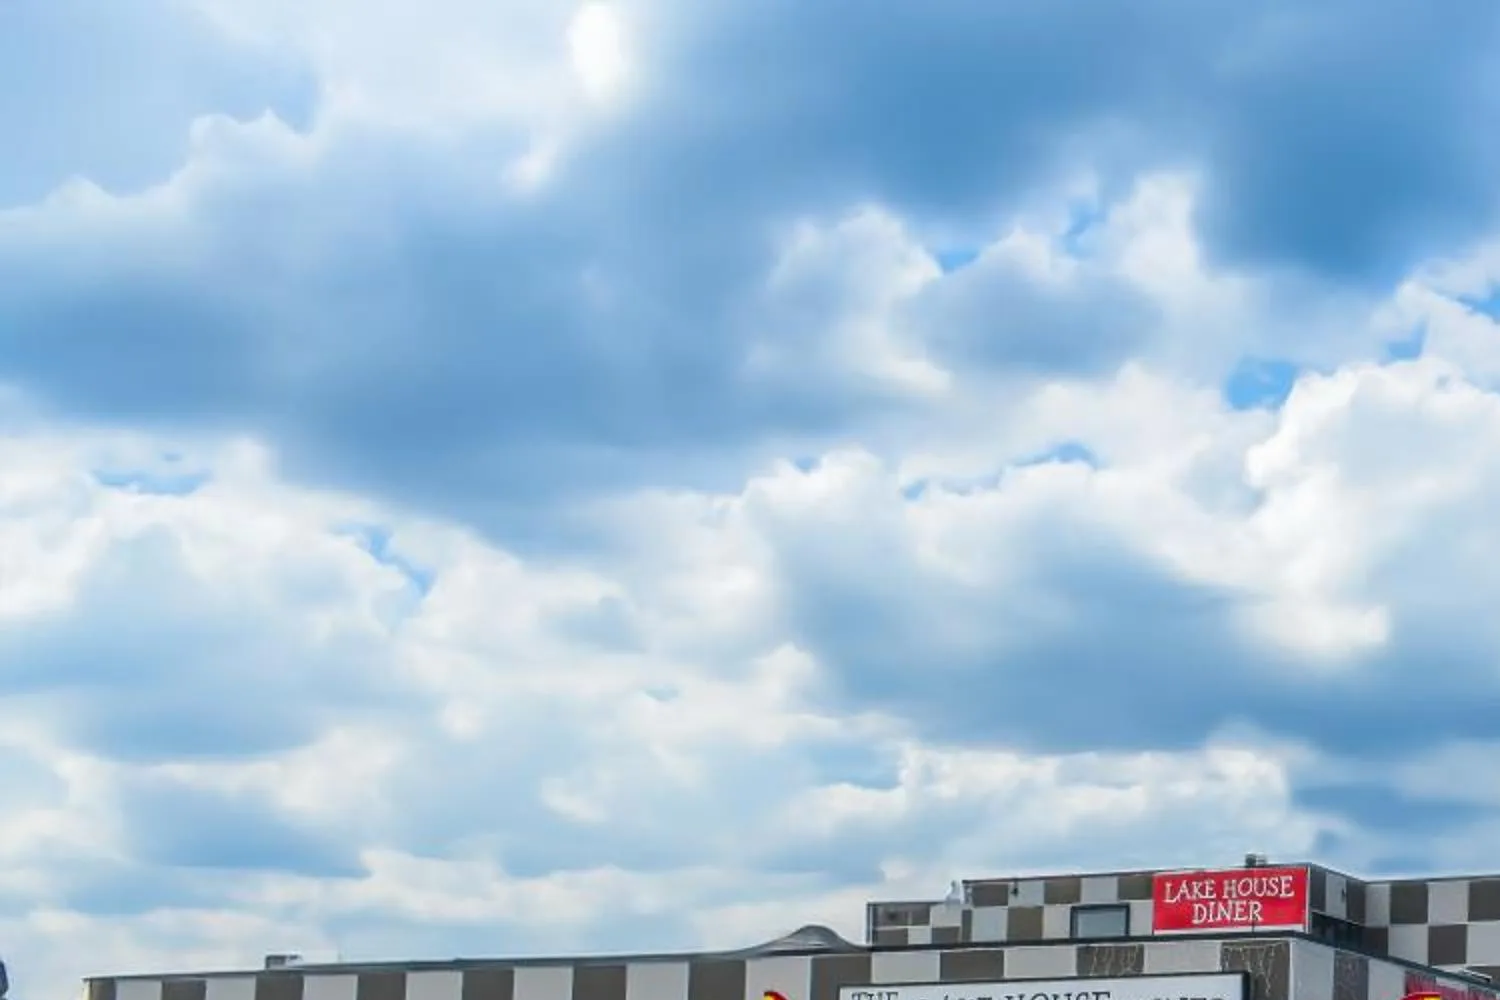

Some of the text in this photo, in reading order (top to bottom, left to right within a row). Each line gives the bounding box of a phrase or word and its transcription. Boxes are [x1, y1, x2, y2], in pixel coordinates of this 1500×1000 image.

[1164, 875, 1295, 903] LAKE HOUSE
[1191, 901, 1263, 924] DINER
